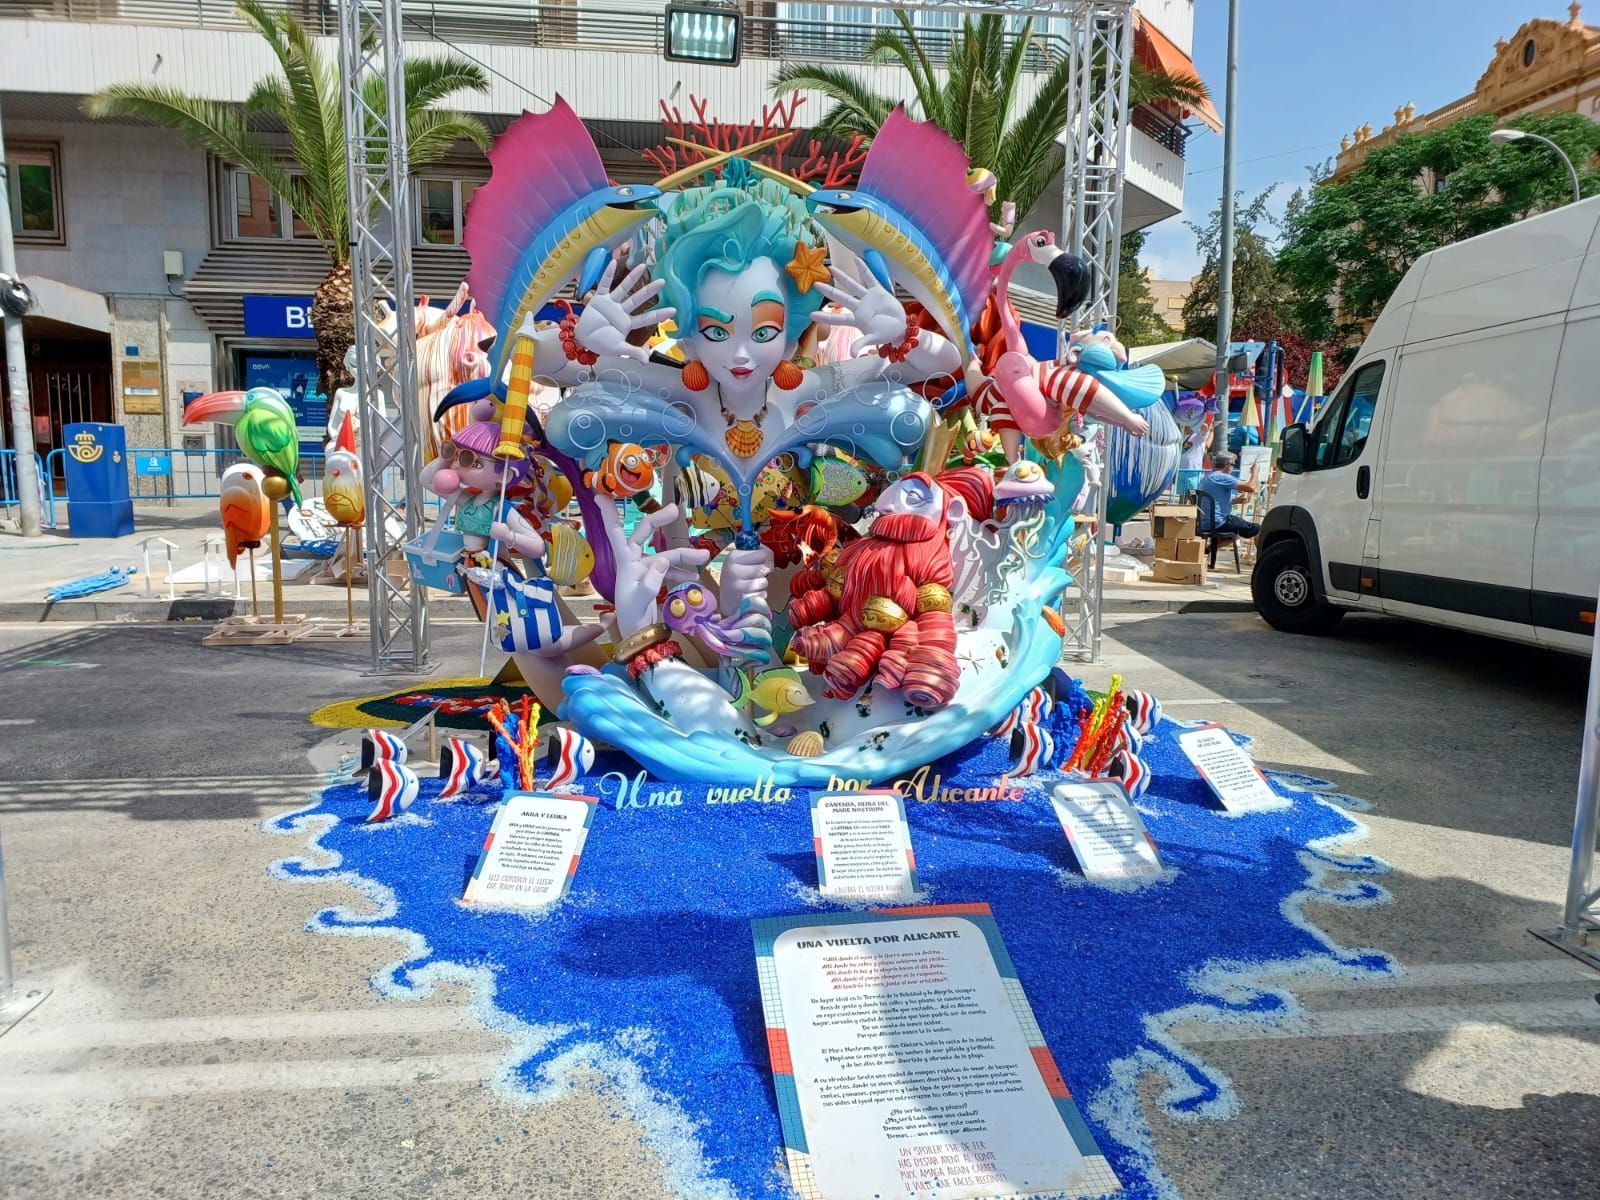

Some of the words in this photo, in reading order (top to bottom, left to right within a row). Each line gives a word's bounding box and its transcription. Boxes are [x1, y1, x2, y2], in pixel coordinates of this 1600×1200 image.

[600, 770, 683, 808] Una
[706, 774, 794, 805] vuelta
[827, 774, 872, 791] por
[894, 765, 1023, 804] Alicante
[796, 938, 823, 950] UNA
[826, 936, 871, 946] VUELTA
[874, 934, 900, 944] POR
[903, 930, 960, 942] ALICANTE
